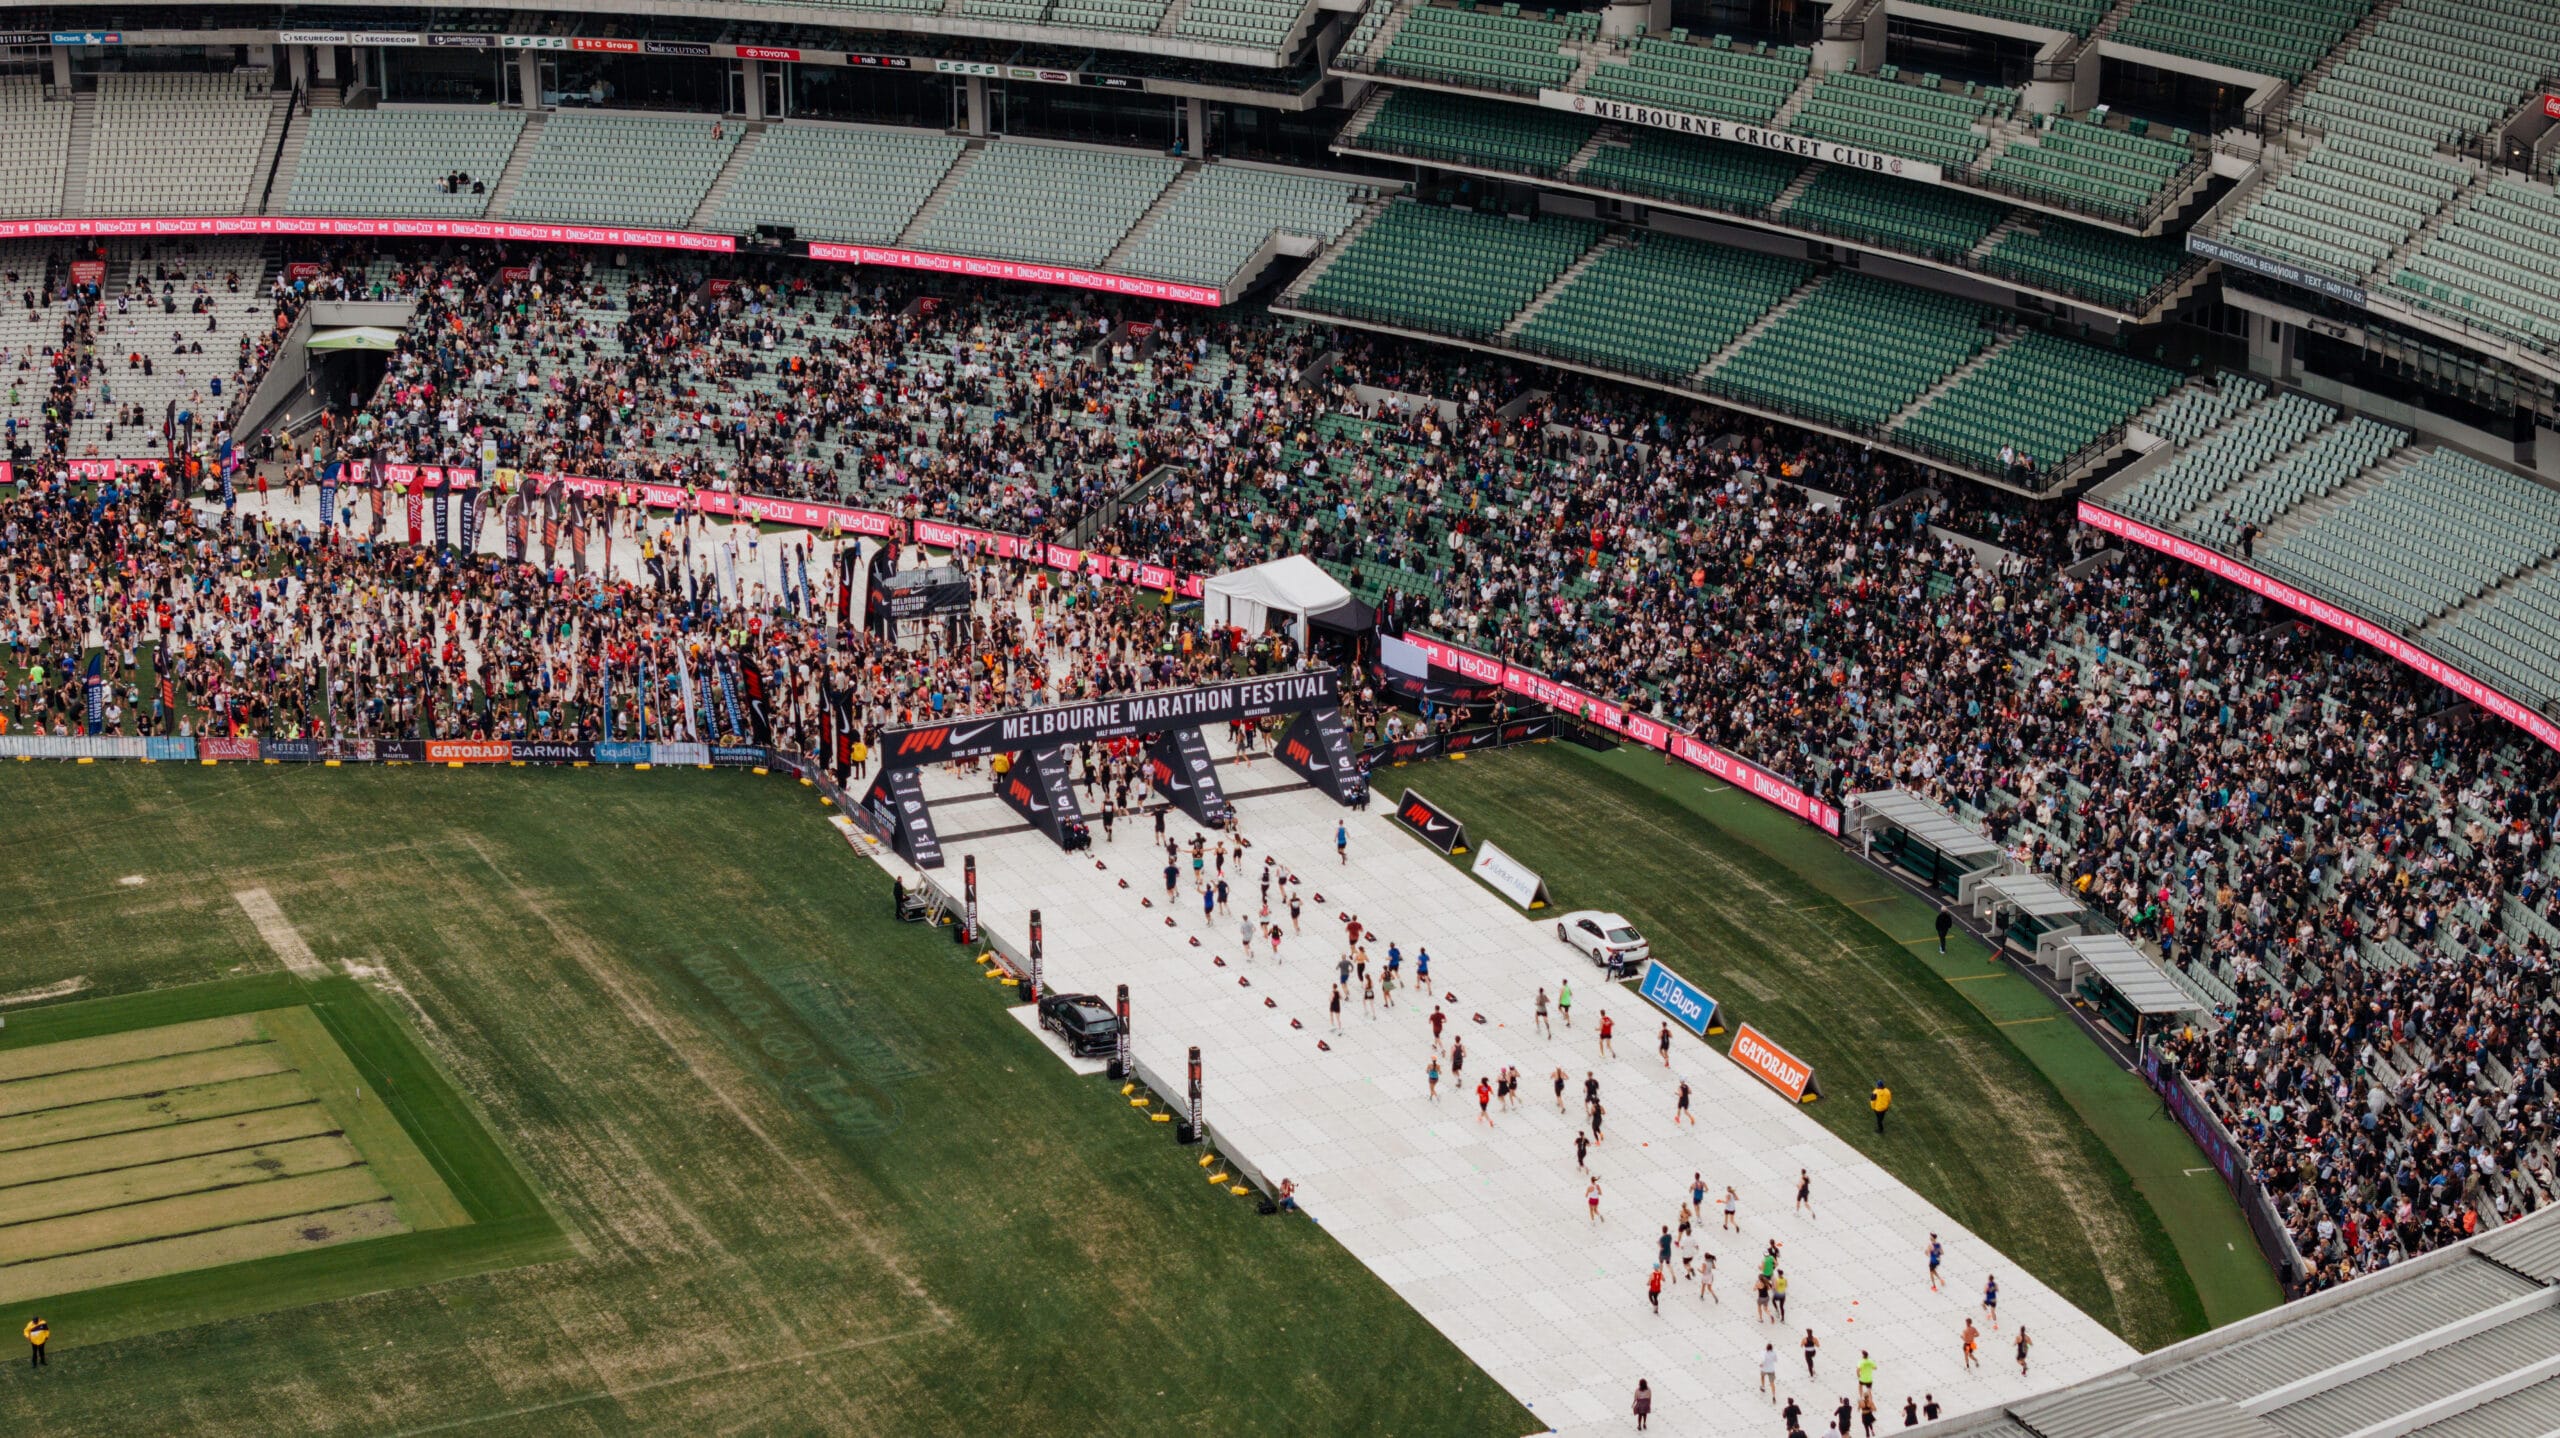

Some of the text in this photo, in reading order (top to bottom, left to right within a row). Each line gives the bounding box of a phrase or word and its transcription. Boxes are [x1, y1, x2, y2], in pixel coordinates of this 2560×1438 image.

[606, 40, 633, 49] Group
[758, 51, 790, 59] TOYOTA
[861, 56, 906, 66] nab nab
[1594, 100, 1884, 171] MELBOURNE CRICKET CLUB
[58, 223, 76, 232] CITY
[119, 222, 137, 232] CITY
[180, 222, 197, 232] CITY
[240, 221, 256, 230] CITY
[299, 221, 316, 231] CITY
[358, 222, 374, 232] CITY
[416, 223, 433, 234] CITY
[474, 224, 491, 235] CITY
[531, 227, 547, 238] CITY
[588, 230, 605, 241] CITY
[646, 232, 662, 244] CITY
[702, 235, 718, 248] CITY
[832, 246, 847, 258] CITY
[884, 251, 898, 263] CITY
[935, 256, 949, 268] CITY
[986, 262, 1001, 274] CITY
[2192, 239, 2218, 256] REPORT
[2219, 248, 2258, 268] ANTISOCIAL
[2260, 260, 2299, 281] BEHAVIOUR
[2304, 274, 2322, 289] TEXT
[1038, 268, 1053, 280] CITY
[1089, 273, 1103, 287] CITY
[1140, 281, 1153, 294] CITY
[1190, 288, 1204, 301] CITY
[82, 462, 108, 478] CITY
[390, 466, 414, 482] CITY
[582, 480, 605, 497] CITY
[437, 497, 446, 540] FITSTOP
[770, 503, 794, 520] CITY
[2098, 512, 2111, 527] CITY
[464, 501, 473, 546] FITSTOP
[862, 514, 886, 532] CITY
[920, 524, 945, 543] ONLY
[2145, 530, 2159, 546] CITY
[1050, 547, 1072, 567] CITY
[2194, 548, 2207, 565] CITY
[1142, 567, 1164, 586] CITY
[2238, 568, 2251, 584] CITY
[891, 596, 927, 605] MELBOURNE
[2282, 588, 2296, 605] CITY
[891, 603, 924, 612] MARATHON
[2328, 609, 2343, 627] CITY
[2374, 630, 2387, 648] CITY
[1447, 648, 1498, 680] ONLY CITY
[2416, 652, 2429, 670] CITY
[1527, 676, 1576, 710] ONLY CITY
[2459, 676, 2472, 694] CITY
[1003, 676, 1328, 740] MELBOURNE MARATHON FESTIVAL
[1244, 708, 1270, 717] MARATHON
[2503, 701, 2516, 719] CITY
[1109, 726, 1136, 736] MARATHON
[1633, 718, 1654, 741] CITY
[2545, 725, 2558, 745] CITY
[1708, 751, 1728, 774] CITY
[1754, 775, 1800, 809] ONLY CITY
[1670, 987, 1702, 1020] Bupa
[1738, 1036, 1805, 1092] GATORADE
